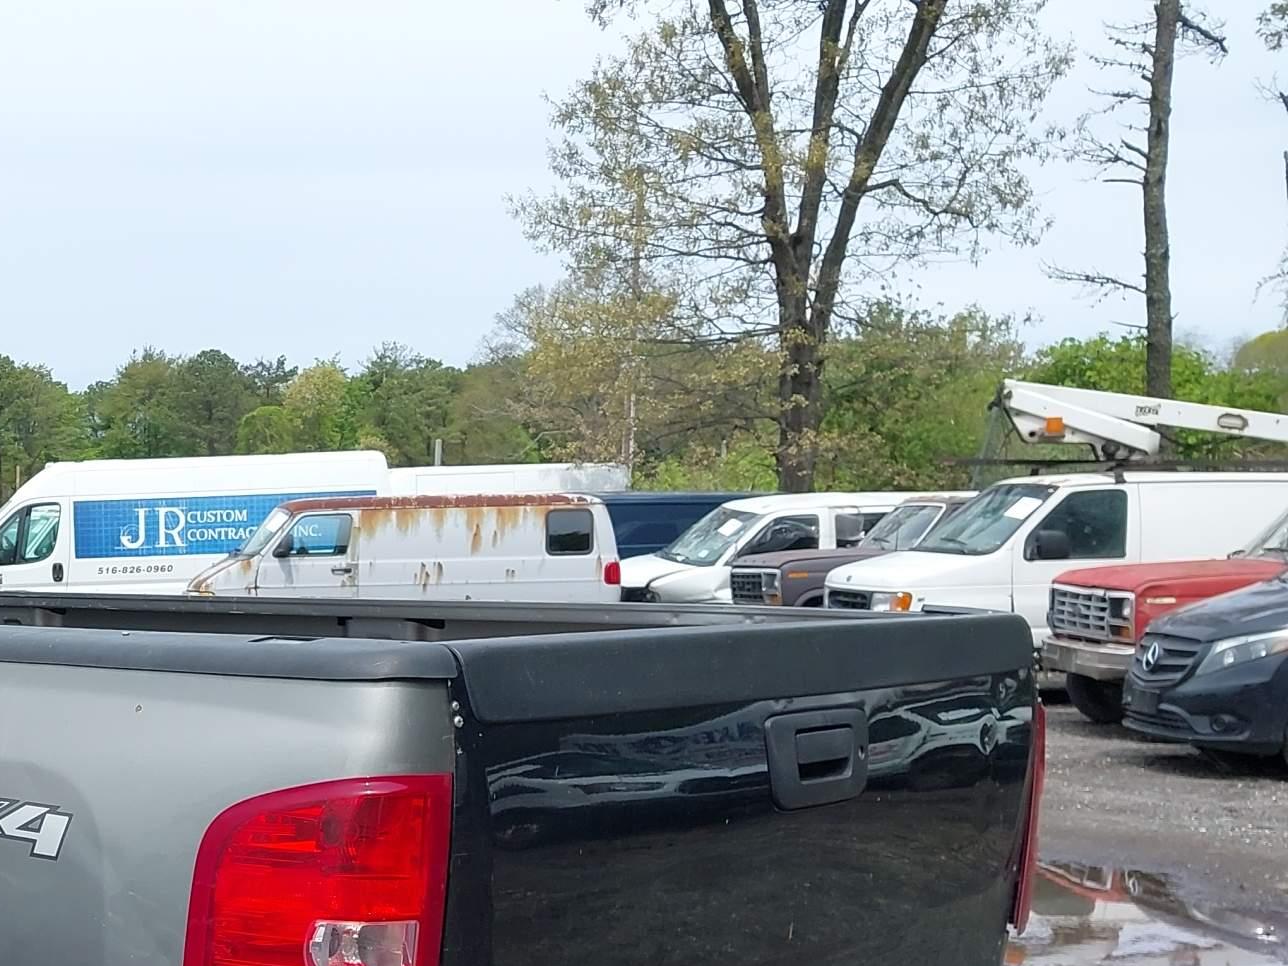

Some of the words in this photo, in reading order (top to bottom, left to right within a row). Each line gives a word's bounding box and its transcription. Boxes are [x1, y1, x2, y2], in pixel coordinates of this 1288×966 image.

[187, 509, 248, 523] CUSTOM
[118, 506, 186, 549] JR
[97, 564, 174, 575] 516-826-0960
